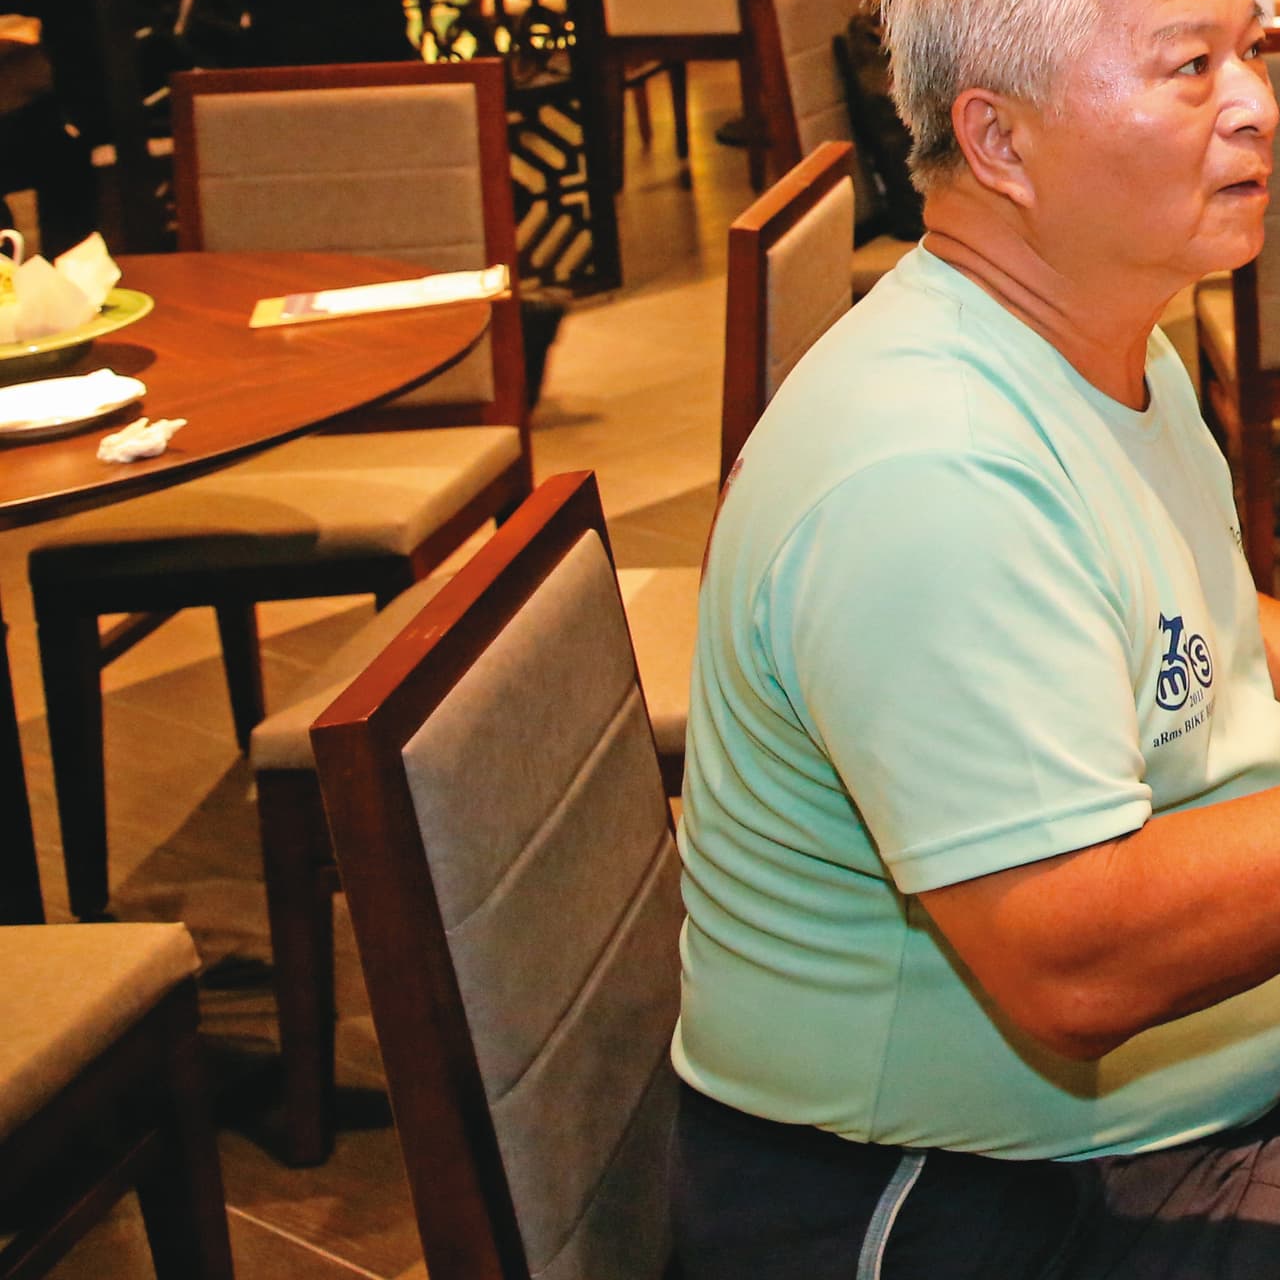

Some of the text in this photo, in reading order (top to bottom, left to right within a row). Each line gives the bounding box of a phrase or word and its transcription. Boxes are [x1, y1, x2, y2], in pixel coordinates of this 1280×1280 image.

[1189, 689, 1204, 708] 2011
[1153, 711, 1206, 748] aRms BIKE
